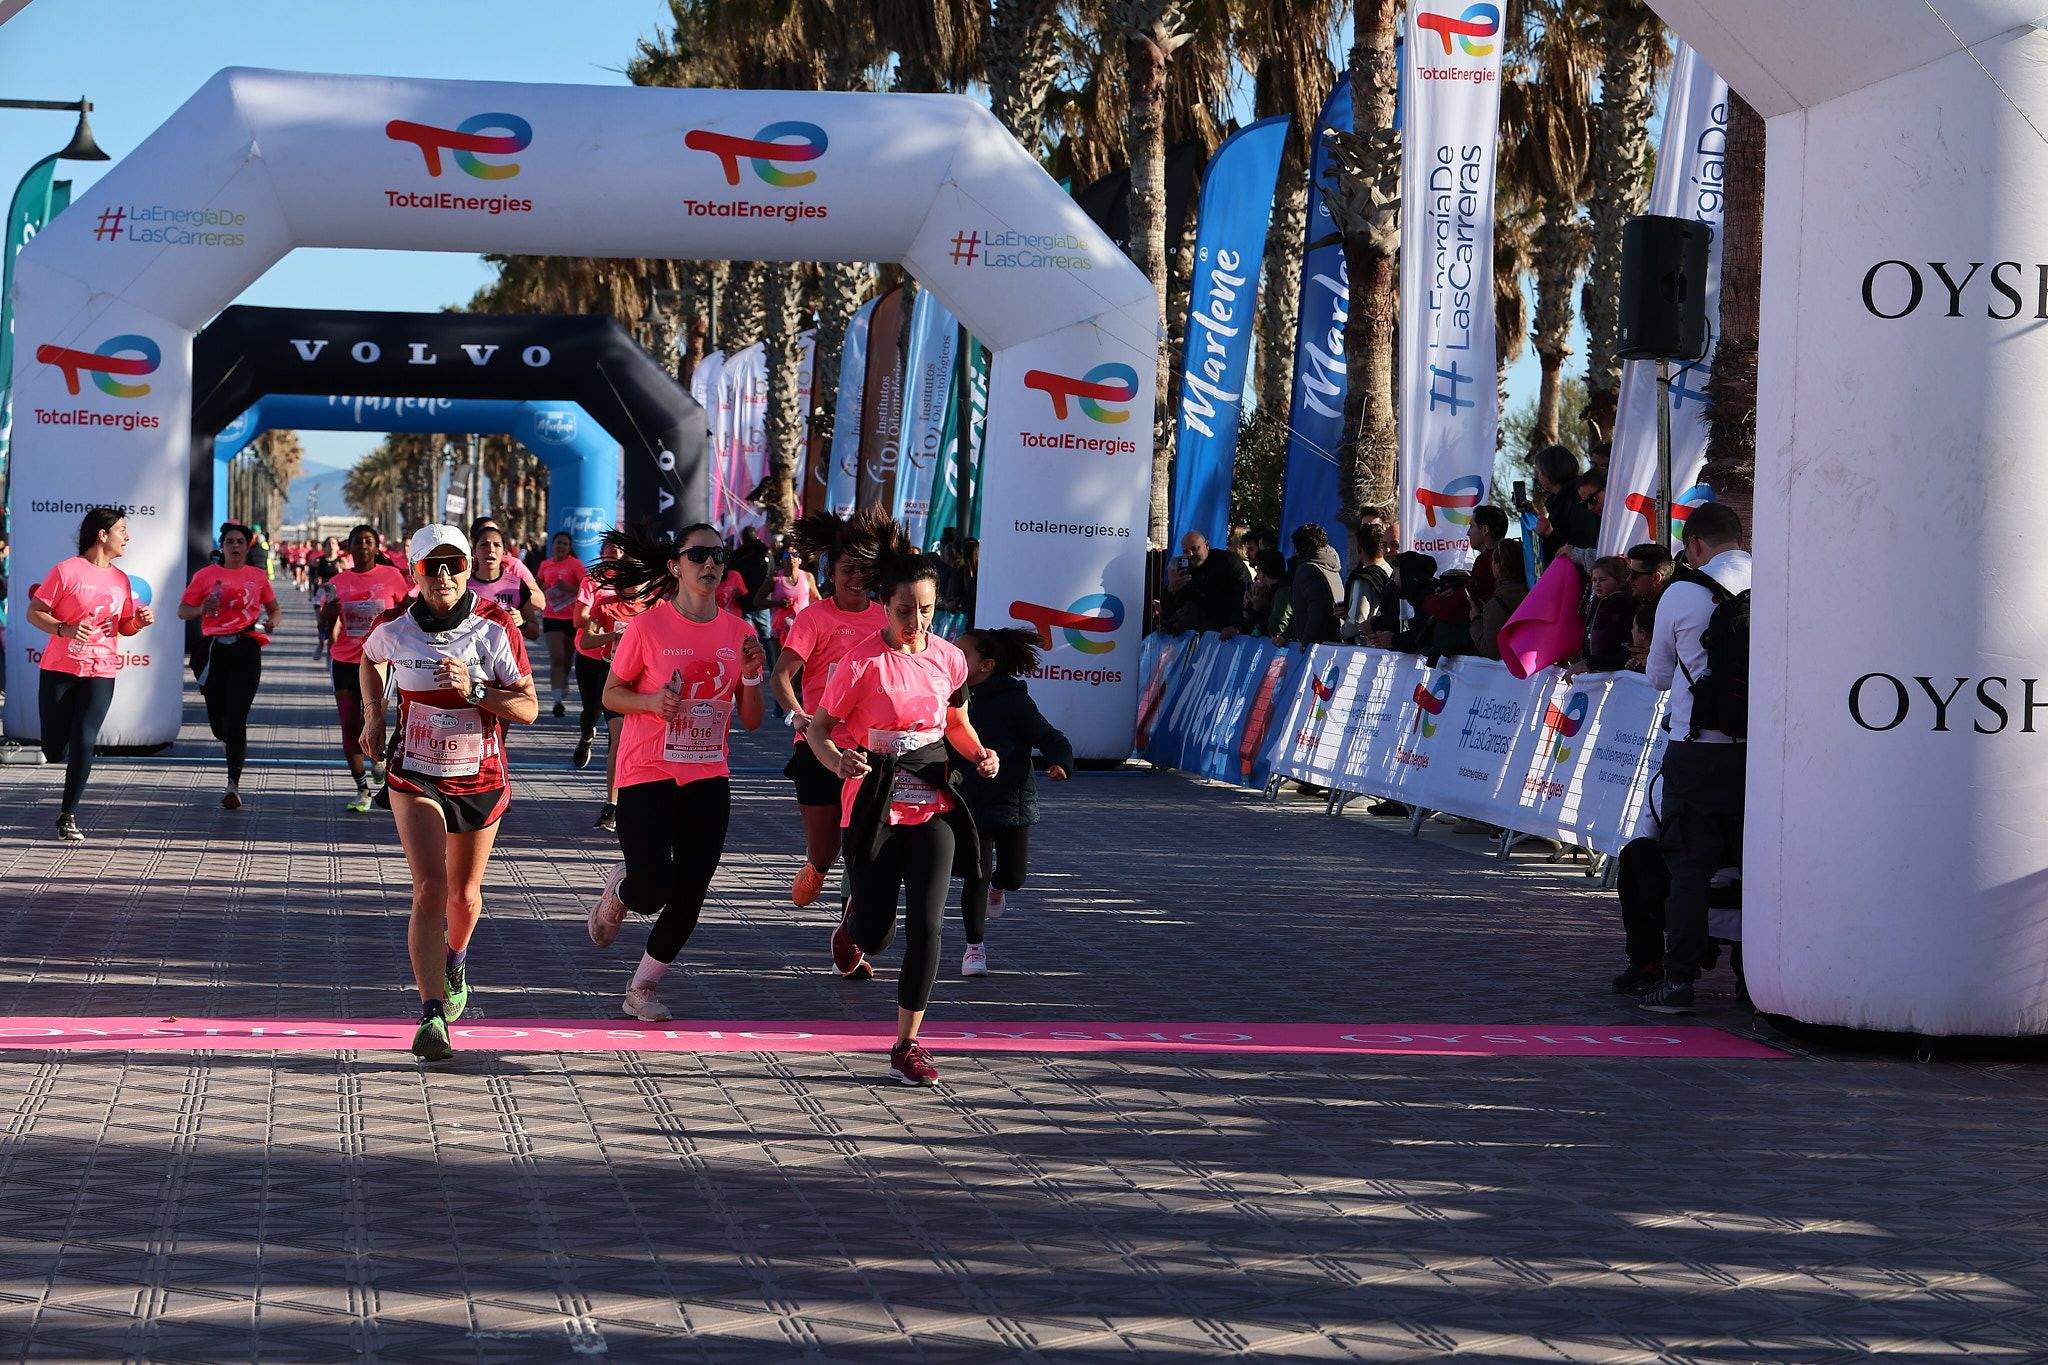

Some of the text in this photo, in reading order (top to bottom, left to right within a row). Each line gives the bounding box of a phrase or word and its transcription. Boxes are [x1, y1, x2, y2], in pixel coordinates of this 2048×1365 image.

[1417, 66, 1495, 84] TotalEnergies
[384, 191, 532, 215] TotalEnergies
[683, 200, 828, 222] TotalEnergies
[129, 225, 245, 246] LasCarreras
[1446, 145, 1482, 351] LasCarreras
[984, 250, 1092, 271] LasCarreras
[1861, 260, 2048, 320] OYS
[289, 339, 551, 368] VOLVO
[1182, 248, 1247, 439] Marlene
[919, 363, 936, 422] Institutos
[876, 375, 891, 435] Institutos
[34, 409, 160, 431] TotalEnergies
[1020, 432, 1136, 456] TotalEnergies
[1014, 520, 1130, 538] totalenergies.es
[494, 593, 514, 604] 30K
[662, 648, 694, 656] OYSHO
[691, 728, 712, 738] 016
[429, 738, 458, 751] 016
[454, 1029, 812, 1040] OYSHO
[915, 1031, 1253, 1041] OYSHO
[1340, 1034, 1682, 1044] OYSHO
